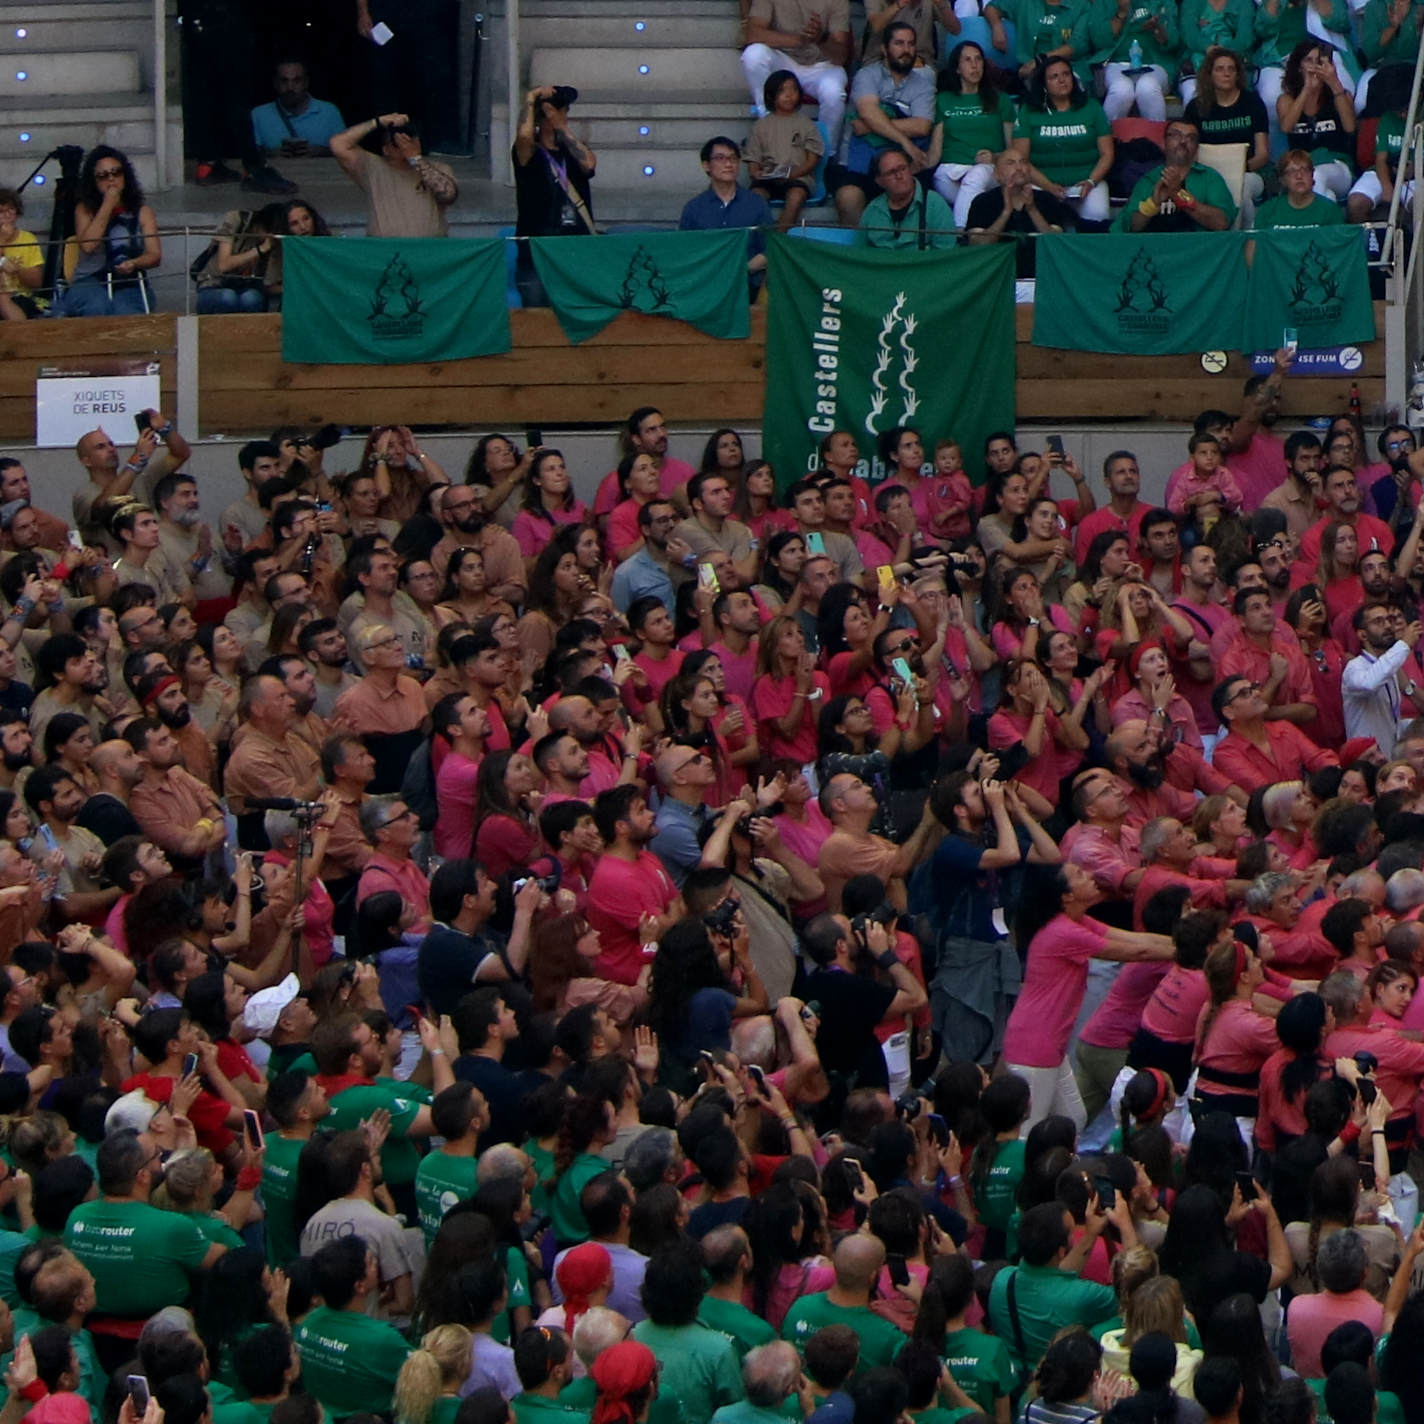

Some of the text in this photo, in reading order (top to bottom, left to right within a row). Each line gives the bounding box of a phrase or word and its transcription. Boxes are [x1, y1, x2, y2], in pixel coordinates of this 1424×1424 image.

[809, 287, 843, 433] Castellers
[1316, 354, 1337, 364] FUM
[74, 390, 125, 402] XIQUETS
[73, 402, 127, 415] DE REUS
